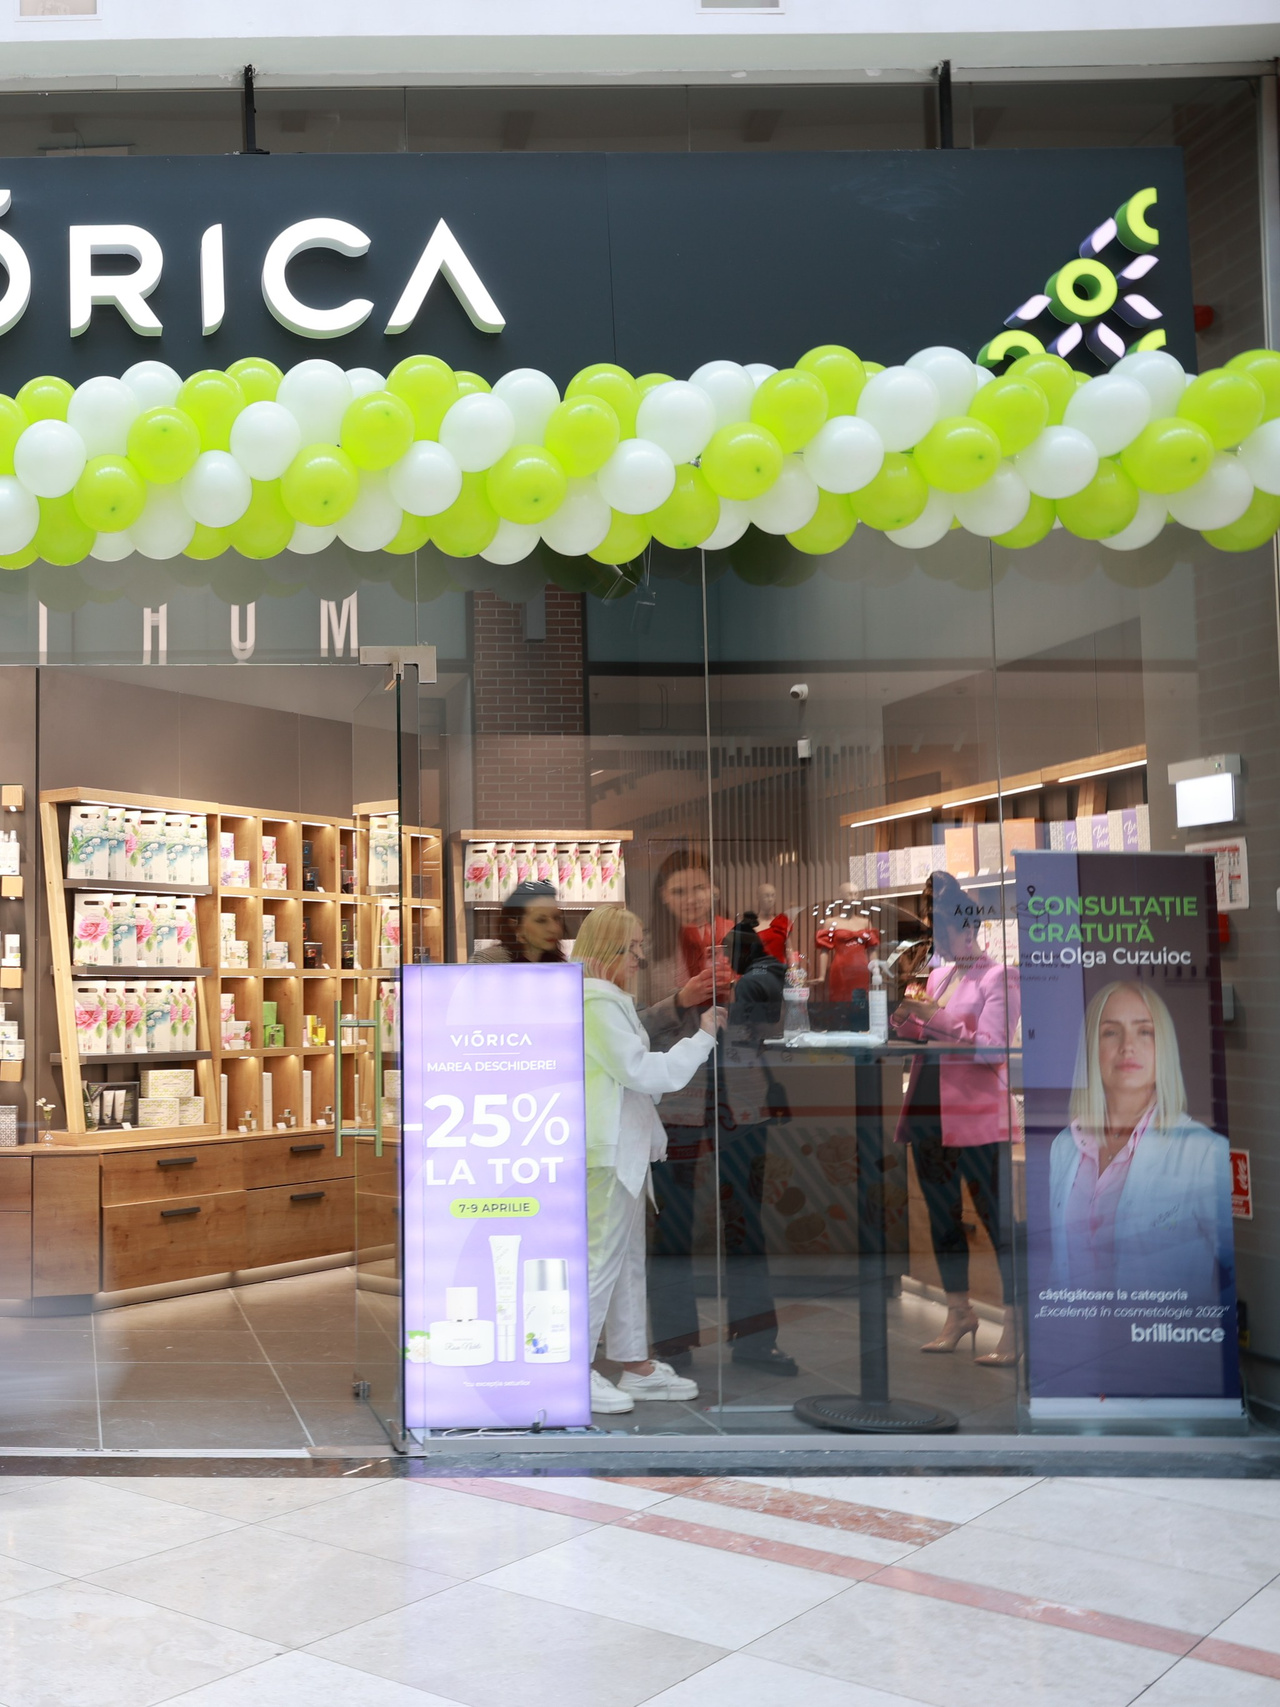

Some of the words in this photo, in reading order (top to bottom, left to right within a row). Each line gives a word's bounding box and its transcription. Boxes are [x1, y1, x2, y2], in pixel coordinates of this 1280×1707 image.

[1028, 896, 1198, 923] CONSULTAȚIE
[1028, 918, 1155, 943] GRATUITĂ
[1031, 950, 1053, 965] cu
[1060, 947, 1107, 968] Olga
[1112, 946, 1191, 965] Cuzuioc
[427, 1061, 473, 1072] MAREA
[475, 1060, 556, 1072] DESCHIDERE!
[402, 1092, 570, 1149] -25%
[426, 1157, 476, 1186] LA
[487, 1155, 564, 1185] TOT
[459, 1203, 479, 1213] 7-9
[481, 1202, 530, 1213] APRILIE
[1117, 1288, 1128, 1301] la
[1130, 1289, 1188, 1303] categoria
[1100, 1305, 1111, 1317] în
[1113, 1305, 1193, 1320] cosmetologie
[1131, 1323, 1226, 1343] brilliance
